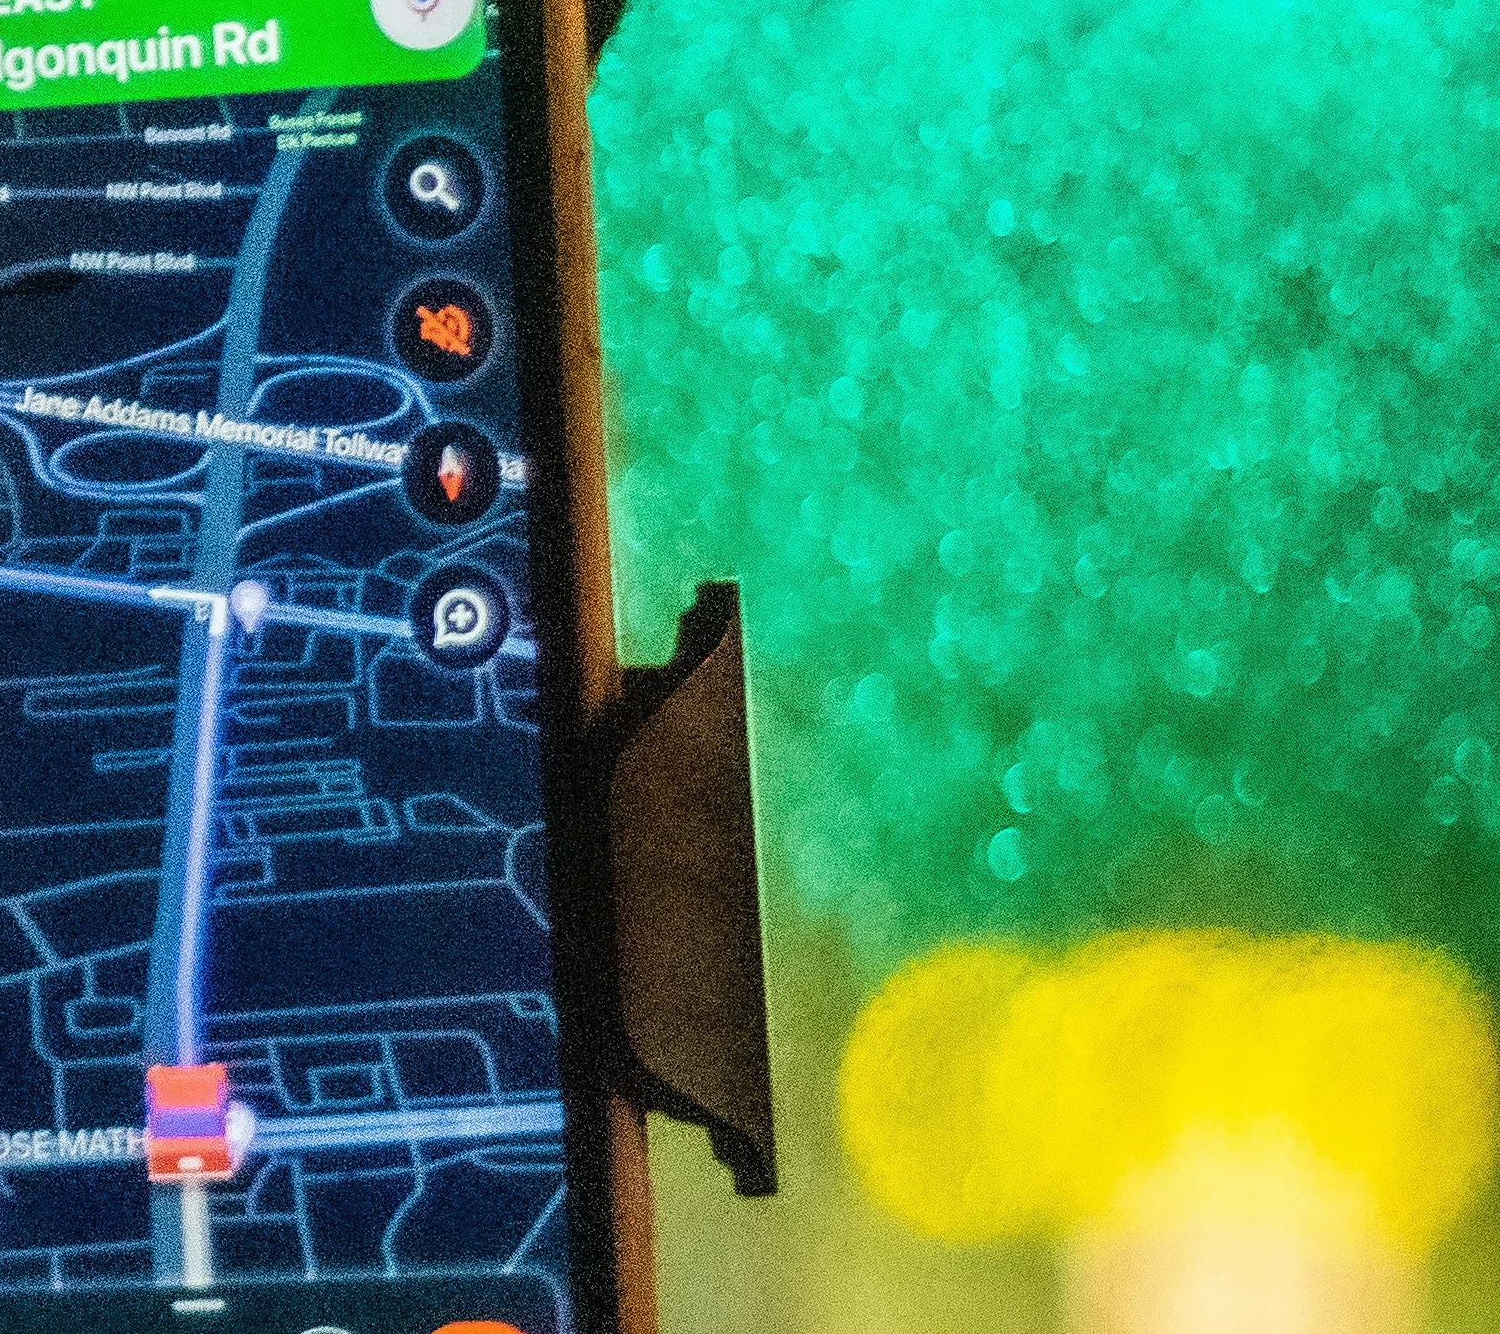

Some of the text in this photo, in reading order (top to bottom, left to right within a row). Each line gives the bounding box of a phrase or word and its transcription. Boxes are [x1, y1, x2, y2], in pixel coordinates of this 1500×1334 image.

[213, 18, 280, 66] Rd
[15, 386, 82, 418] Jane
[82, 394, 191, 433] Addams
[194, 409, 317, 451] Memorial
